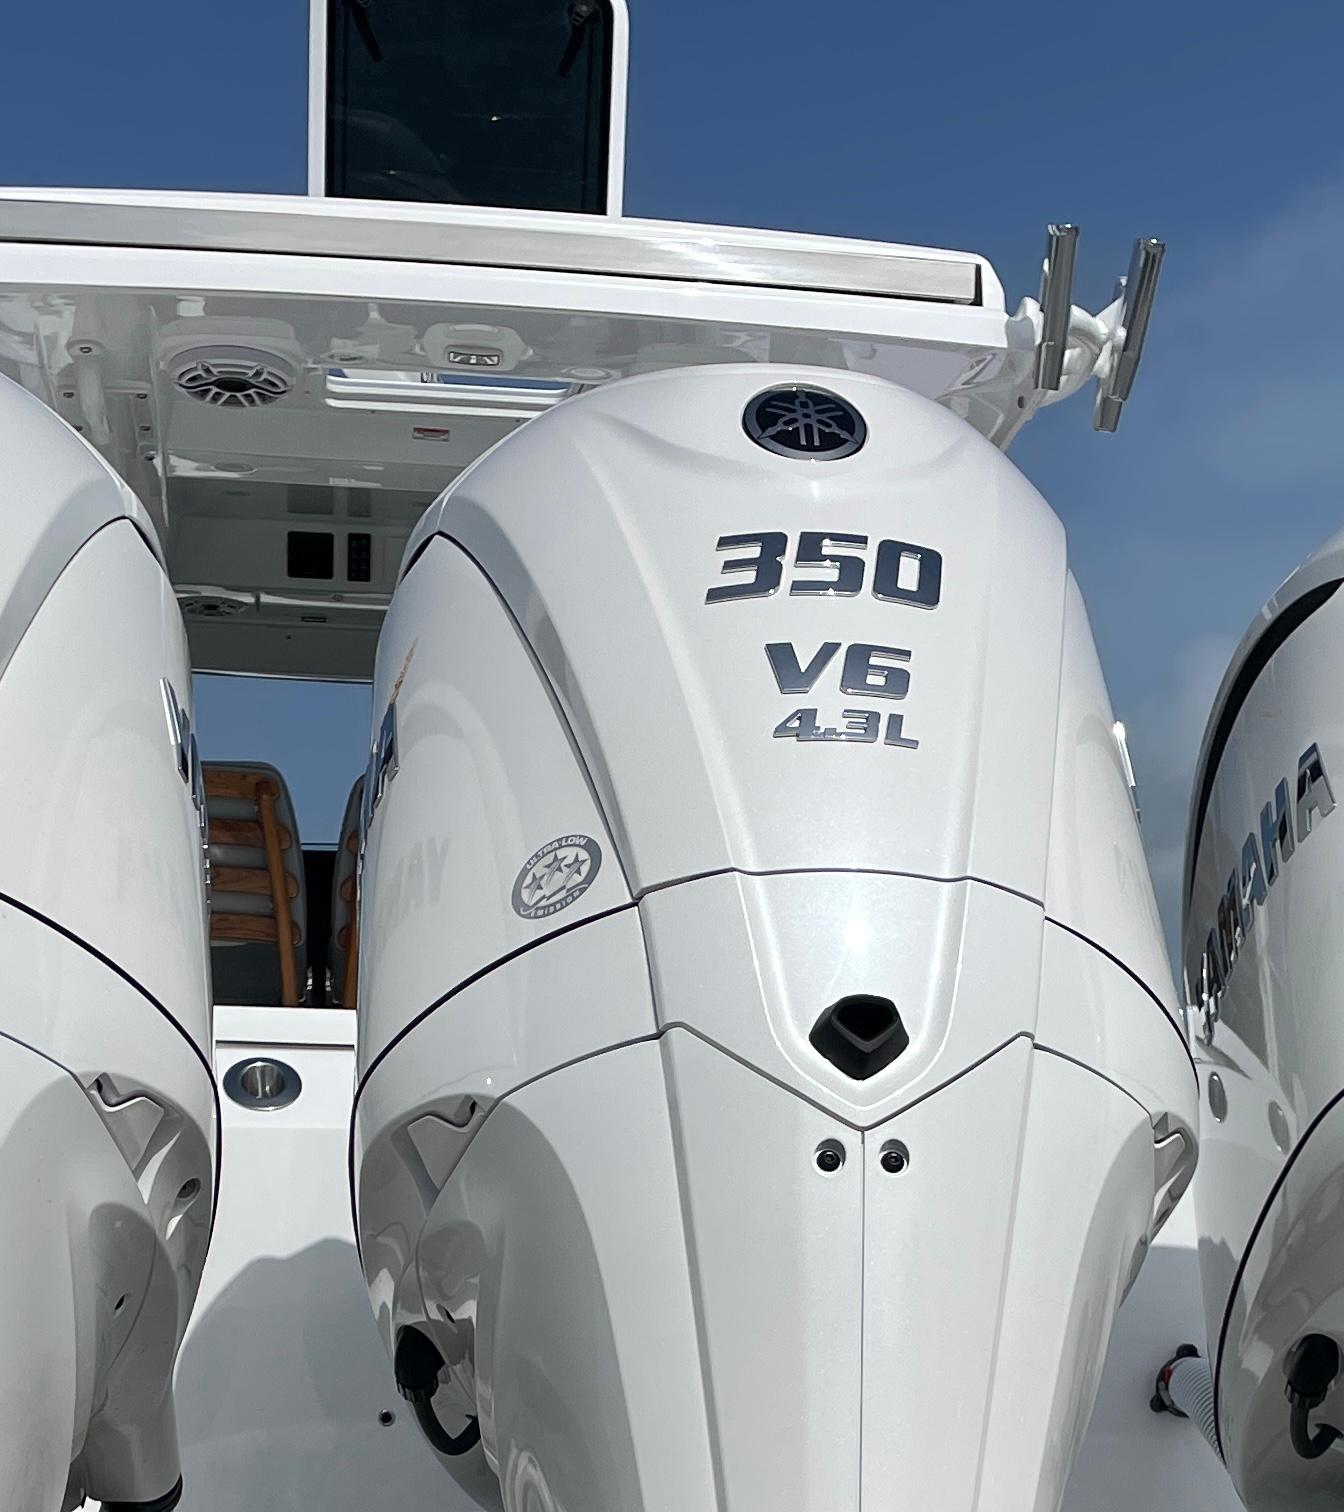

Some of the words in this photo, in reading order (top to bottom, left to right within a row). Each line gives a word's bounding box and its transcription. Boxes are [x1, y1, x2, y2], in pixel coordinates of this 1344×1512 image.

[705, 531, 943, 610] 350
[764, 641, 912, 700] V6
[773, 708, 919, 749] 4.3L
